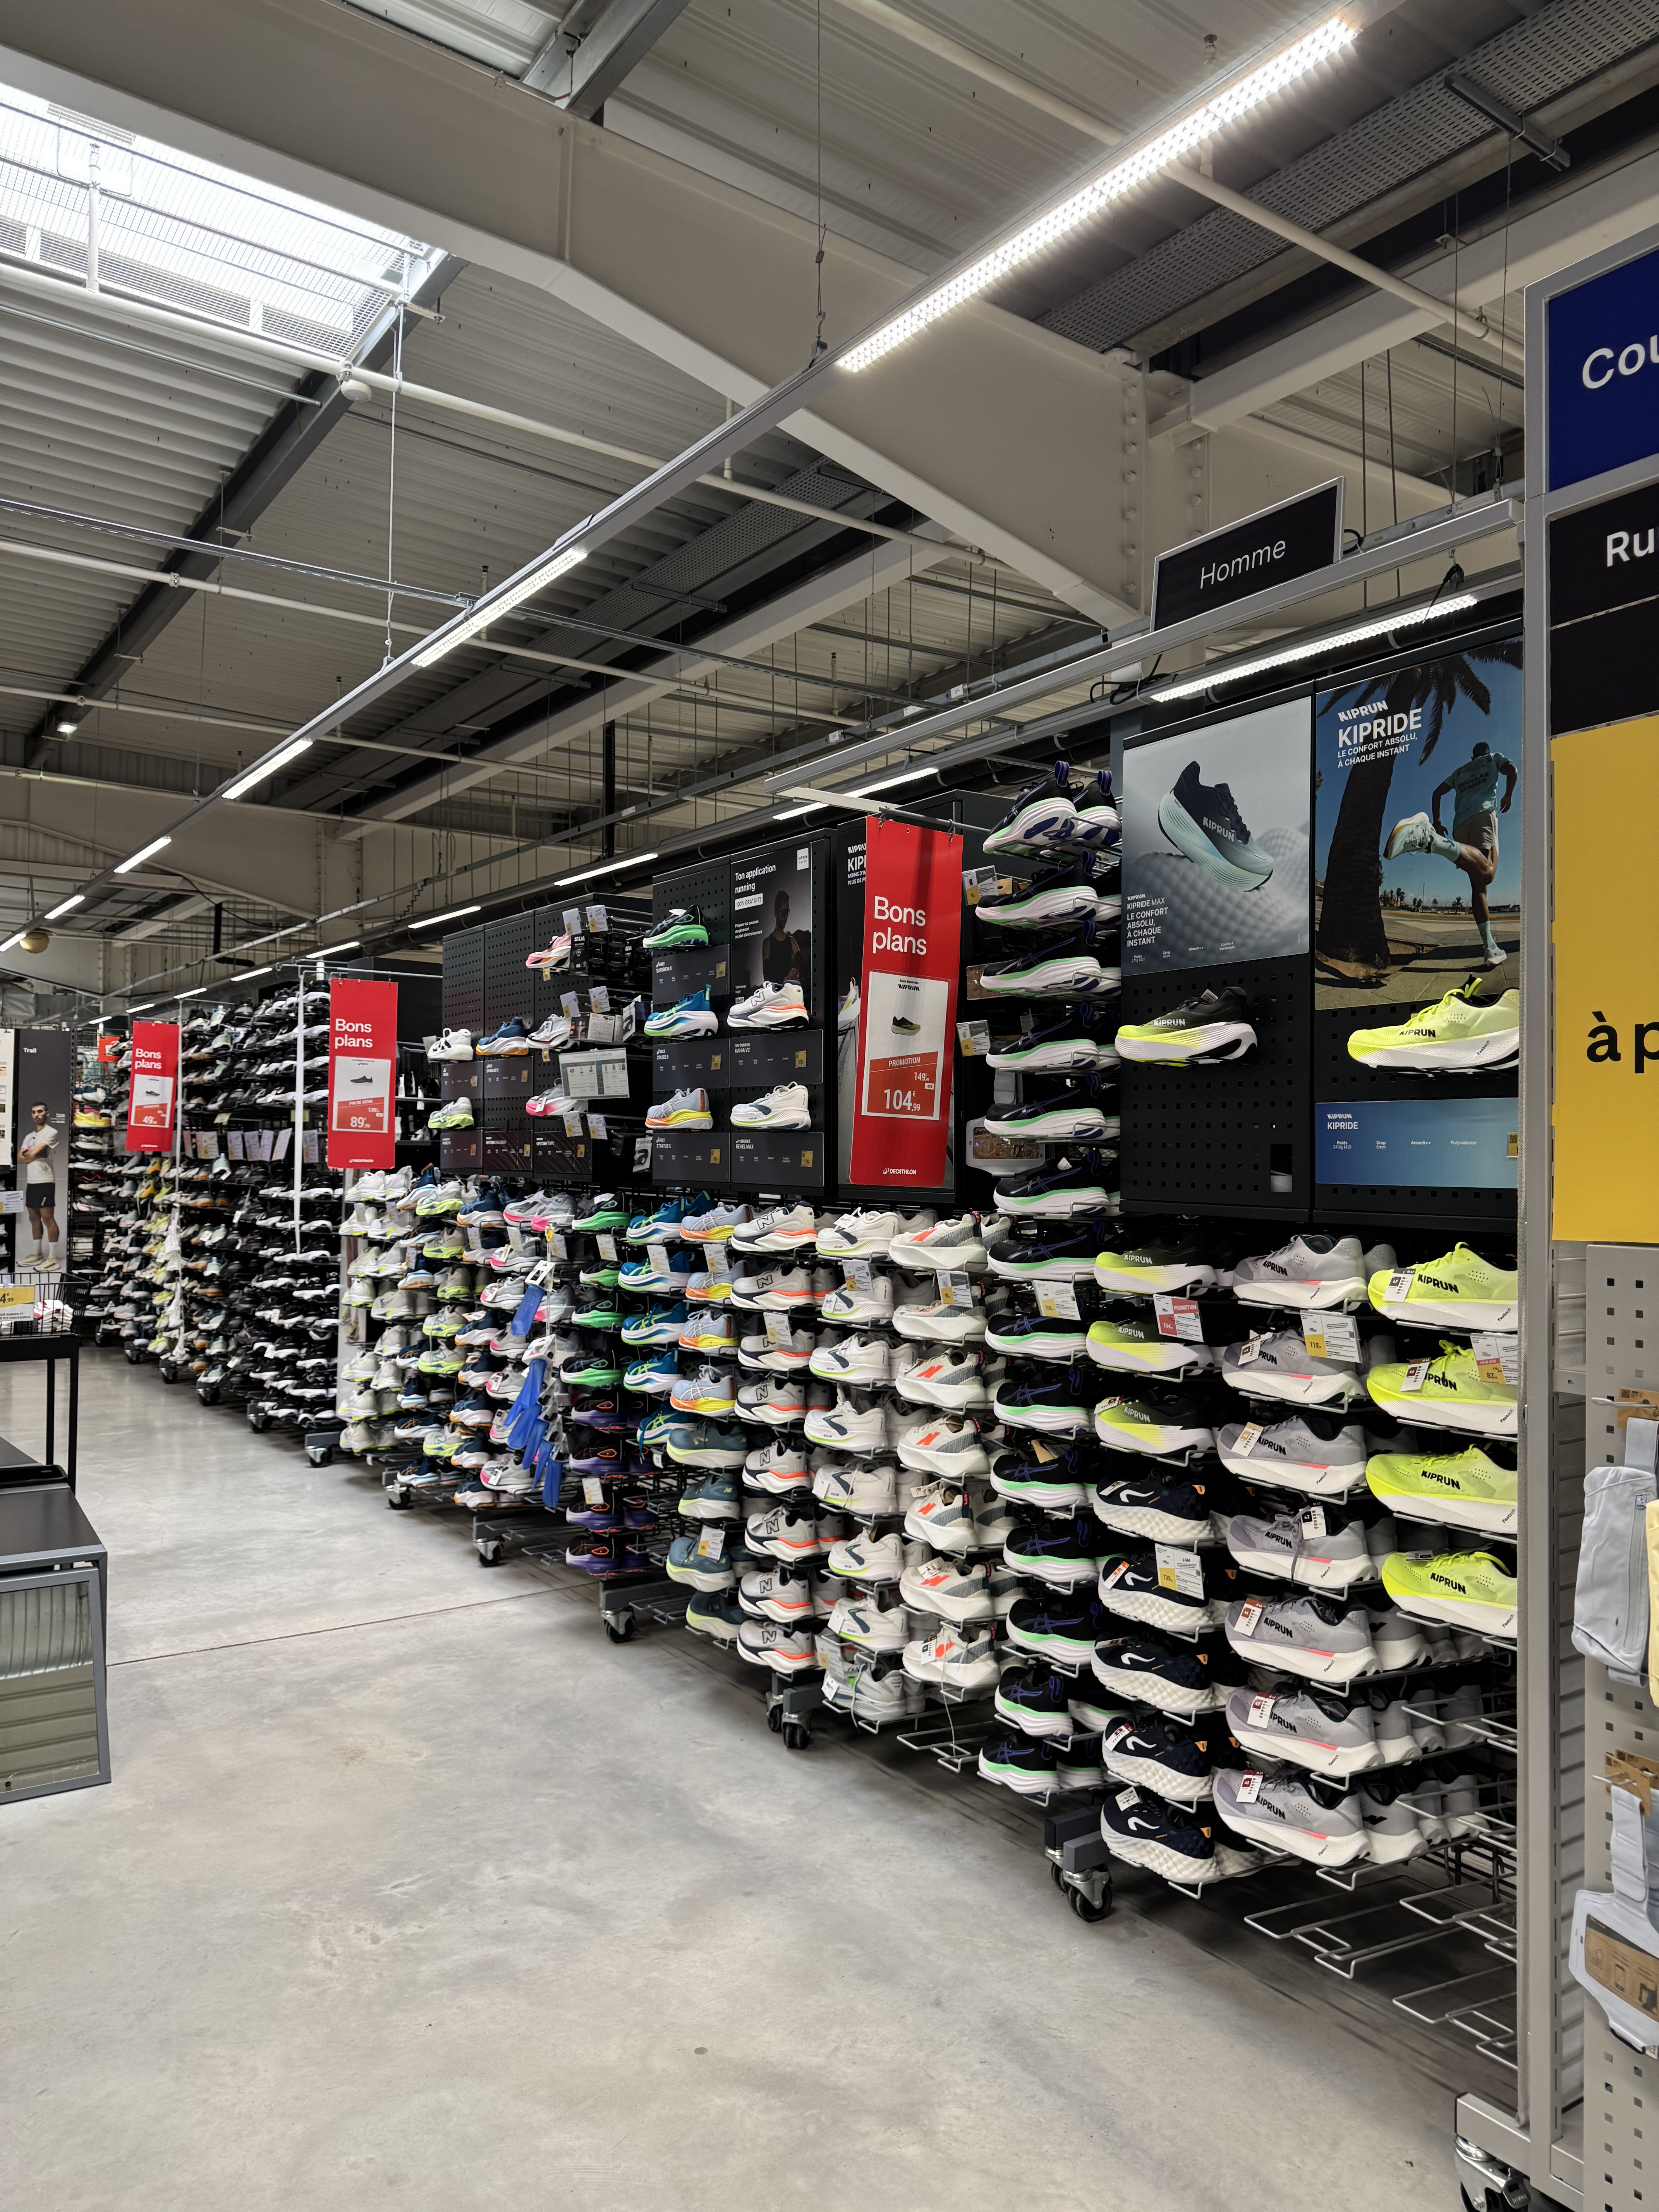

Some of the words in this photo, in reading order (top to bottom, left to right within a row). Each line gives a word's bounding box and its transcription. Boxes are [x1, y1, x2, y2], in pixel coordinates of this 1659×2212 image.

[1200, 540, 1286, 589] Homme
[1338, 700, 1388, 722] KIPRUN
[1338, 708, 1422, 748] KIPRIDE
[1338, 749, 1346, 758] LE
[1348, 740, 1383, 755] CONFORT
[1384, 732, 1418, 746] ABSOLU,
[1338, 758, 1343, 768] À
[1345, 752, 1376, 766] CHAQUE
[1377, 744, 1410, 759] INSTANT
[1202, 816, 1235, 842] KIPRUN
[847, 843, 866, 854] KIPRU
[848, 855, 866, 872] KIP
[735, 872, 745, 881] Ton
[745, 864, 776, 879] application
[735, 883, 755, 894] running
[745, 896, 762, 905] GRATUITE
[1127, 900, 1150, 910] KIPRIDE
[1152, 897, 1165, 906] MAX
[874, 895, 926, 927] Bons
[1127, 913, 1135, 921] LE
[1136, 907, 1168, 919] CONFORT
[1127, 919, 1155, 929] ABSOLU,
[1127, 929, 1132, 938] À
[1133, 926, 1161, 938] CHAQUE
[872, 928, 927, 956] plans
[1127, 936, 1155, 947] INSTANT
[335, 1018, 372, 1033] Bons
[1153, 1018, 1186, 1027] KIPRUN
[1399, 1029, 1436, 1038] KIPRUN
[1587, 1011, 1621, 1063] à
[335, 1035, 373, 1049] plans
[135, 1048, 162, 1059] Bons
[888, 1056, 920, 1067] PROMOTION
[134, 1059, 162, 1069] plans
[1327, 1121, 1358, 1130] KIPRIDE
[1124, 1254, 1152, 1264] KIPRUN
[1262, 1260, 1288, 1276] KIPRUN
[1417, 1274, 1459, 1294] KIPRUN
[1118, 1326, 1145, 1339] KIPRUN
[1259, 1350, 1277, 1365] PRUN
[1424, 1372, 1457, 1391] IPRUN
[1124, 1406, 1151, 1423] KIPRUN
[1421, 1470, 1461, 1490] KIPRUN
[1265, 1531, 1293, 1549] KIPRUN
[1430, 1572, 1466, 1595] KIPRUN
[1264, 1617, 1293, 1638] KIPRUN
[1271, 1711, 1297, 1734] IPRUN
